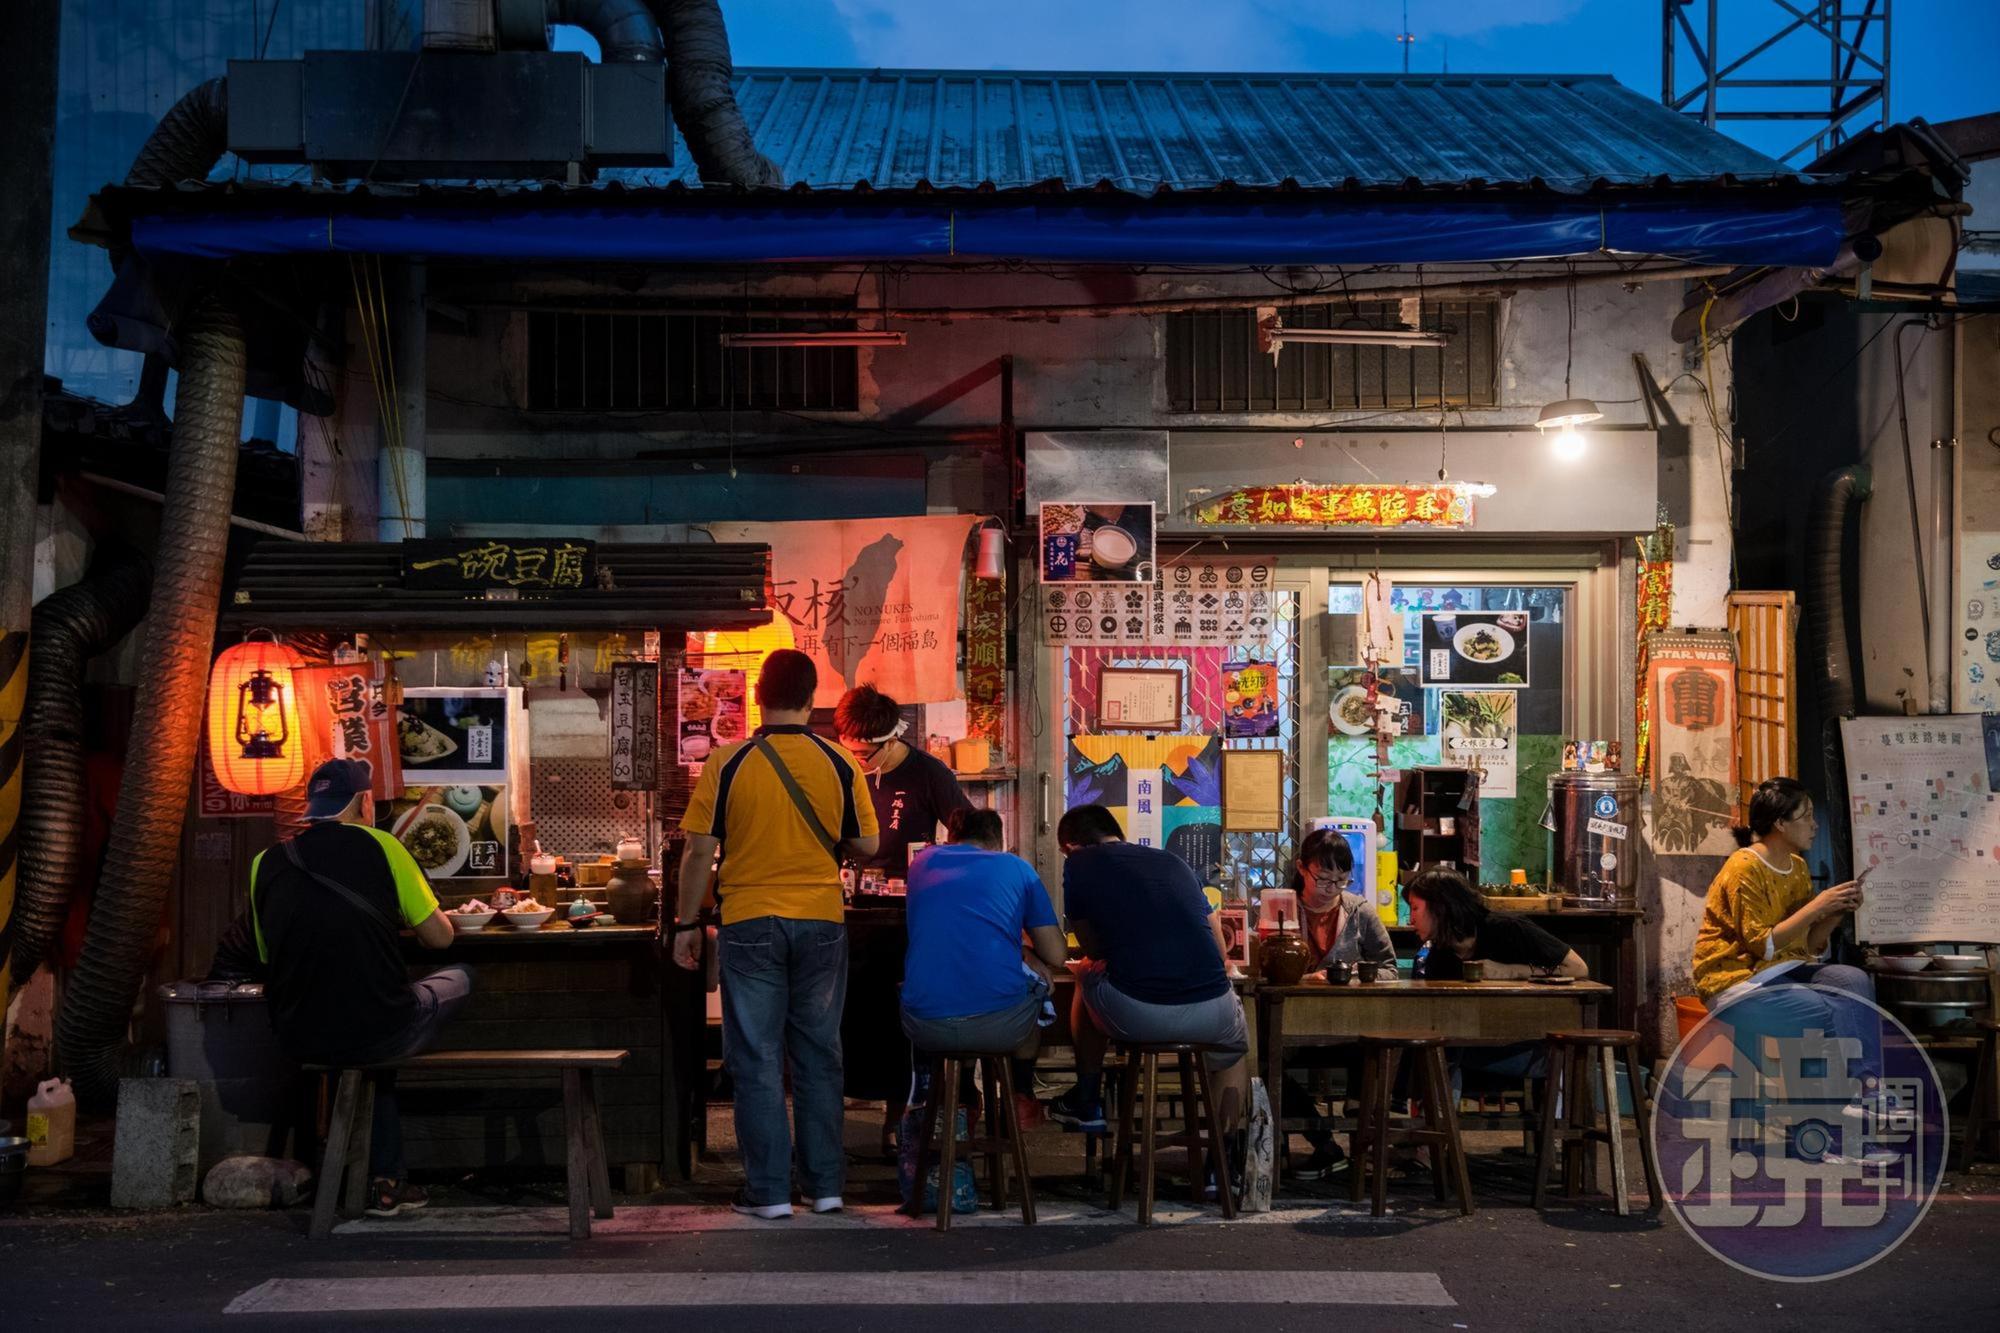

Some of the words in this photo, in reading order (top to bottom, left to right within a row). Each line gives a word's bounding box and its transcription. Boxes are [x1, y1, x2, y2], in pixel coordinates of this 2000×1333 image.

[411, 541, 588, 588] 一碗豆腐
[855, 606, 872, 617] NO
[874, 603, 914, 616] NUKES
[794, 628, 938, 656] 再有下一個福島
[614, 761, 630, 778] 60
[637, 764, 653, 780] 50
[1137, 779, 1152, 814] 南風
